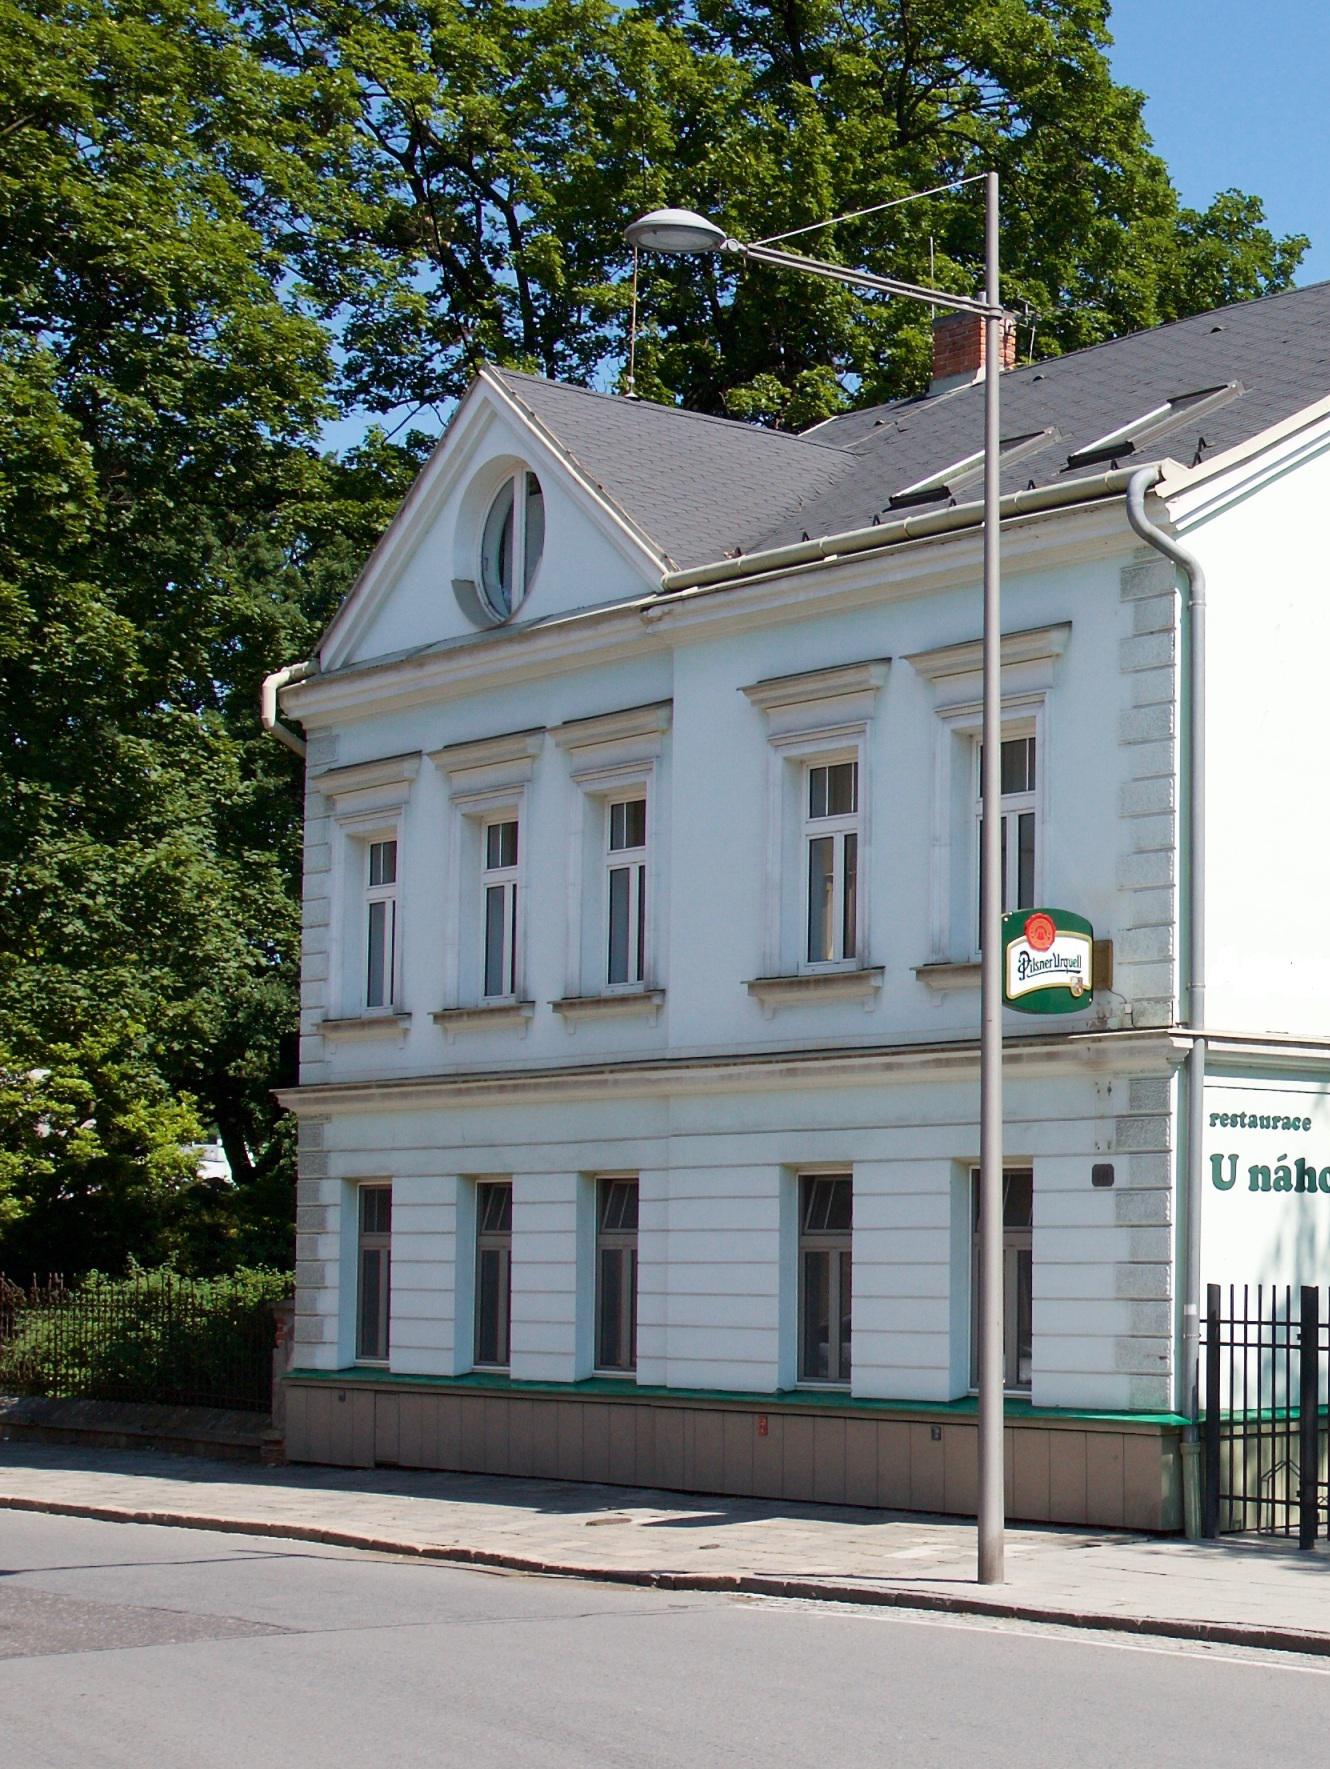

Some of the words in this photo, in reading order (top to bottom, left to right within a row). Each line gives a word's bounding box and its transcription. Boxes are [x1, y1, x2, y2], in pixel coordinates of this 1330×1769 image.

[1018, 951, 1052, 980] Pilsner
[1053, 952, 1081, 974] Urquell
[1209, 1112, 1312, 1131] restaurace
[1210, 1154, 1239, 1191] U
